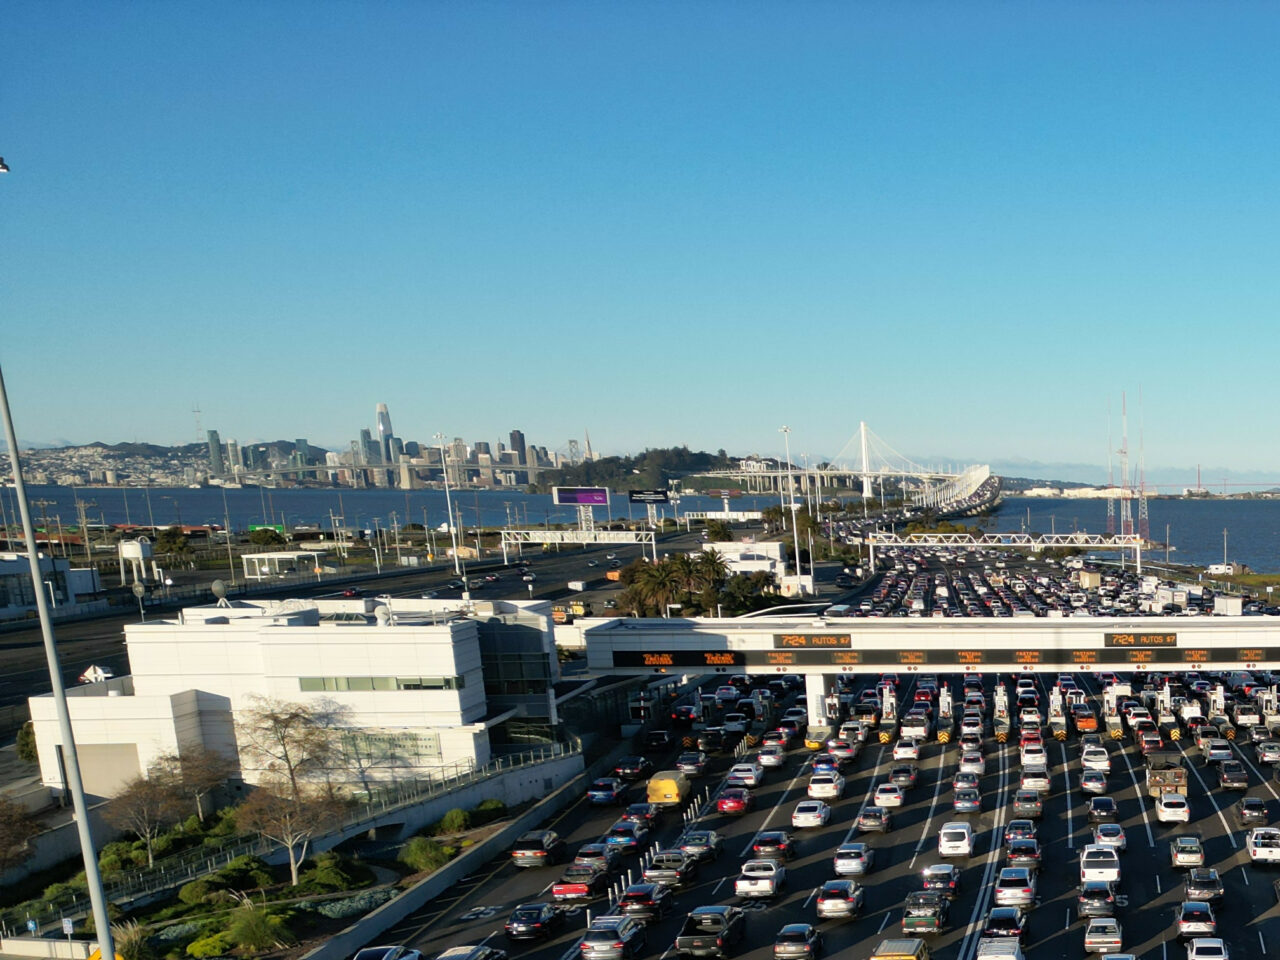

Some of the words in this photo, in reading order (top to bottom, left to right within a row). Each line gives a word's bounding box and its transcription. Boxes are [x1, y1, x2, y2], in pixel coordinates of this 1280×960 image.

[781, 635, 806, 646] 7:24
[812, 636, 837, 645] AUTOS
[1112, 634, 1135, 645] 7:24
[1140, 635, 1163, 643] AUTOS
[1166, 635, 1176, 643] $7
